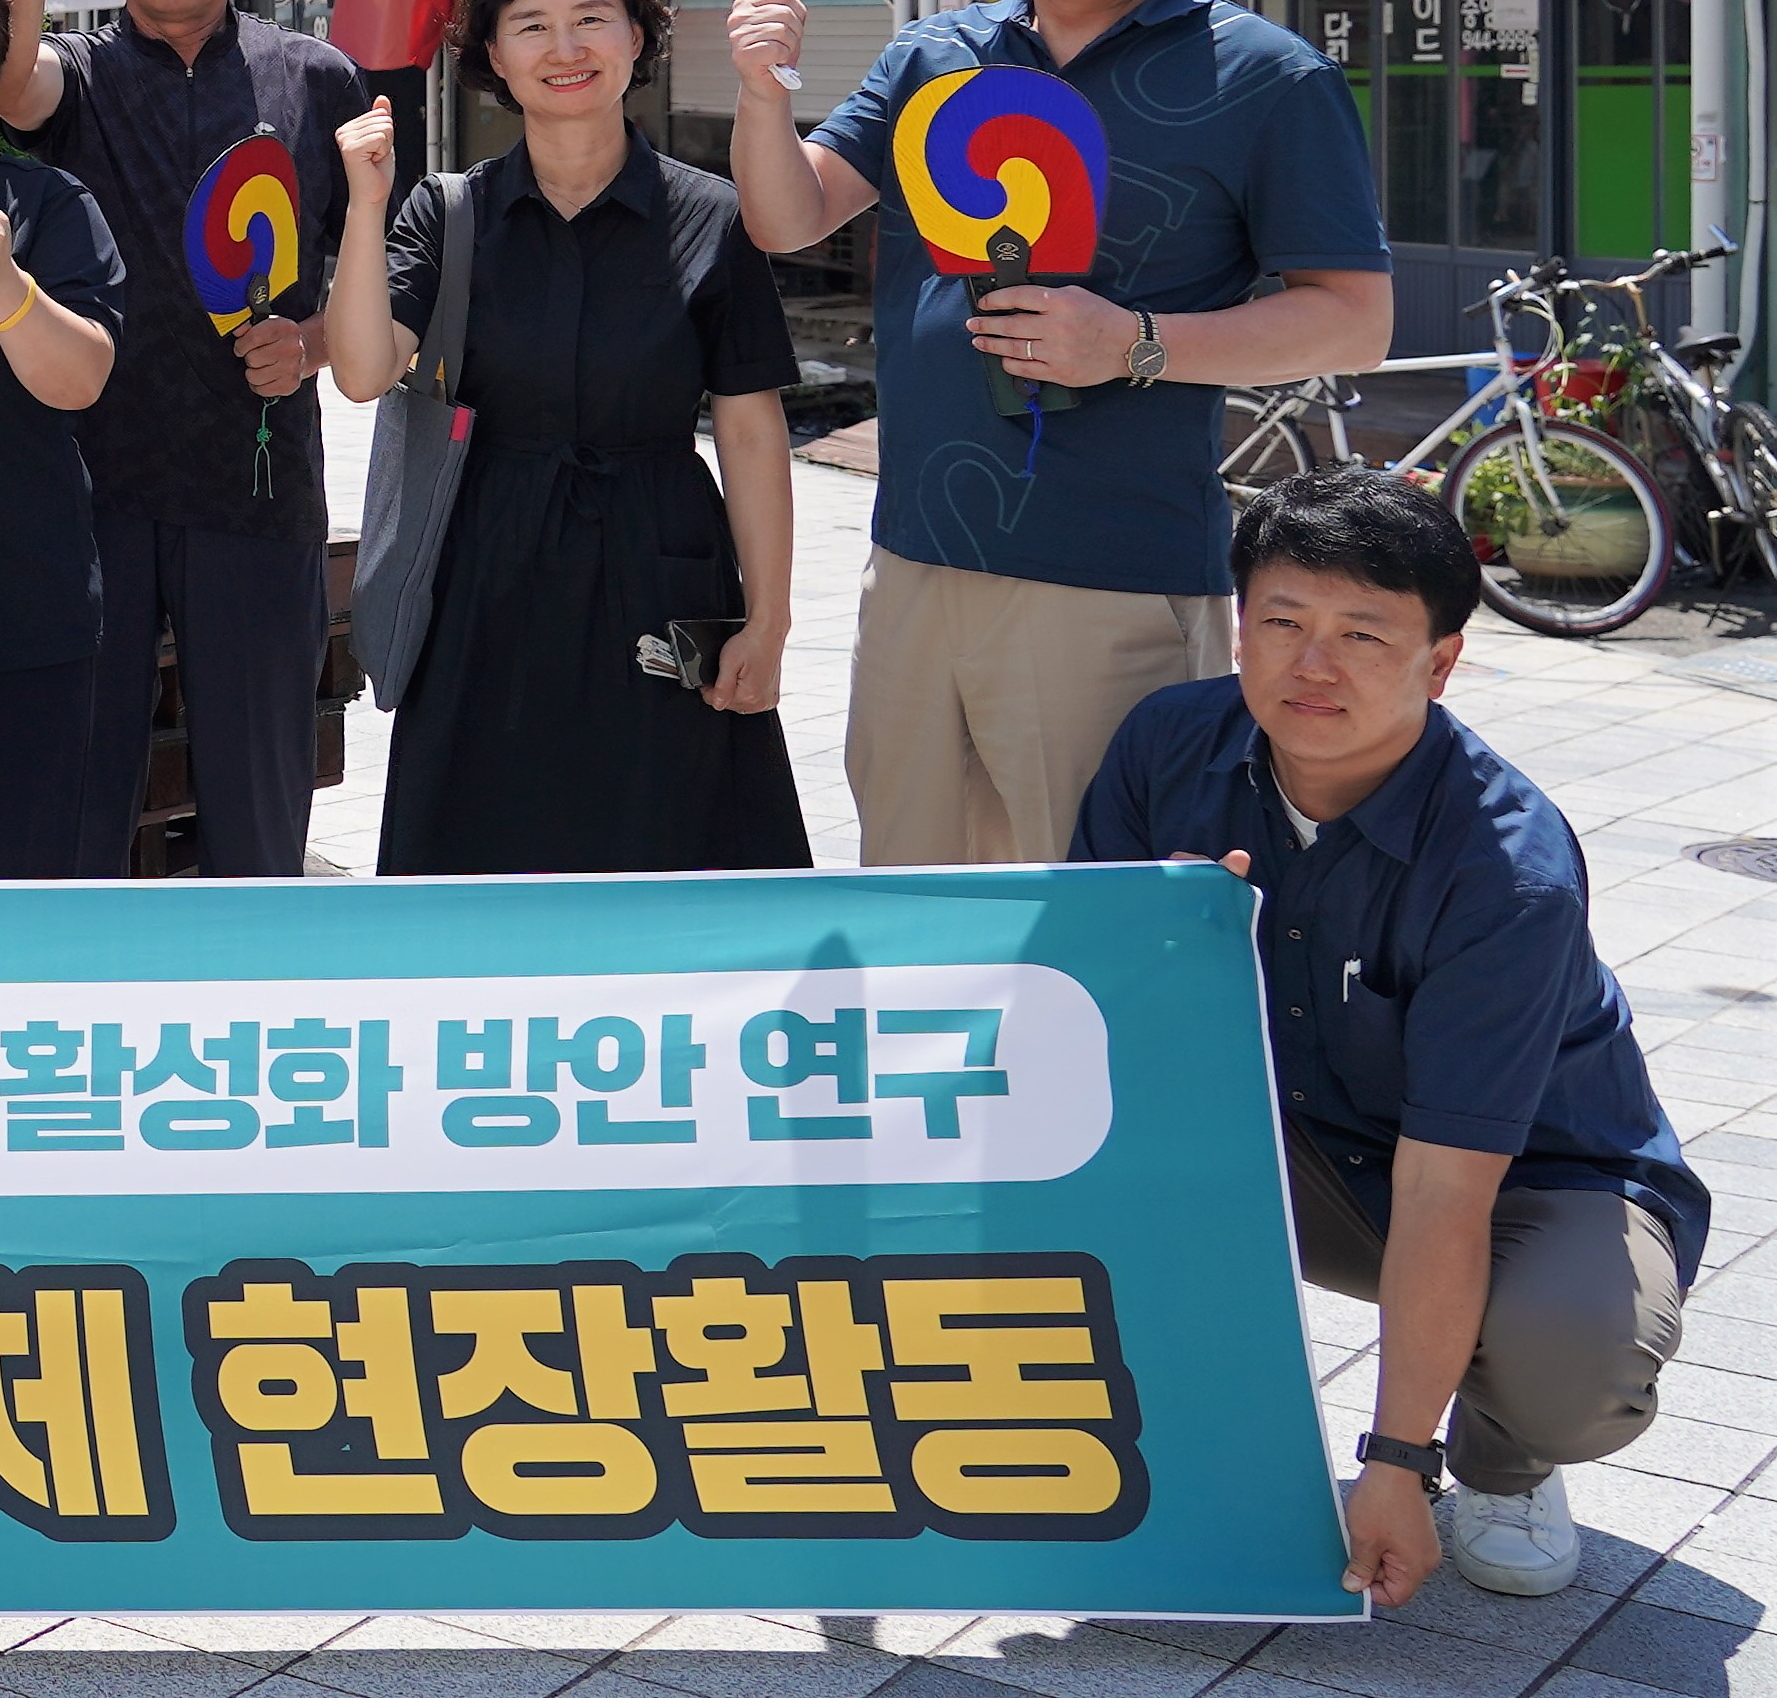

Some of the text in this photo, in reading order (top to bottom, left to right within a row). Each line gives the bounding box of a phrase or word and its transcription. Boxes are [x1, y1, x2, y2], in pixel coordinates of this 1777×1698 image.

[436, 1013, 706, 1148] 방안
[739, 1007, 1010, 1142] 연구
[203, 1274, 1126, 1520] 현장활동
